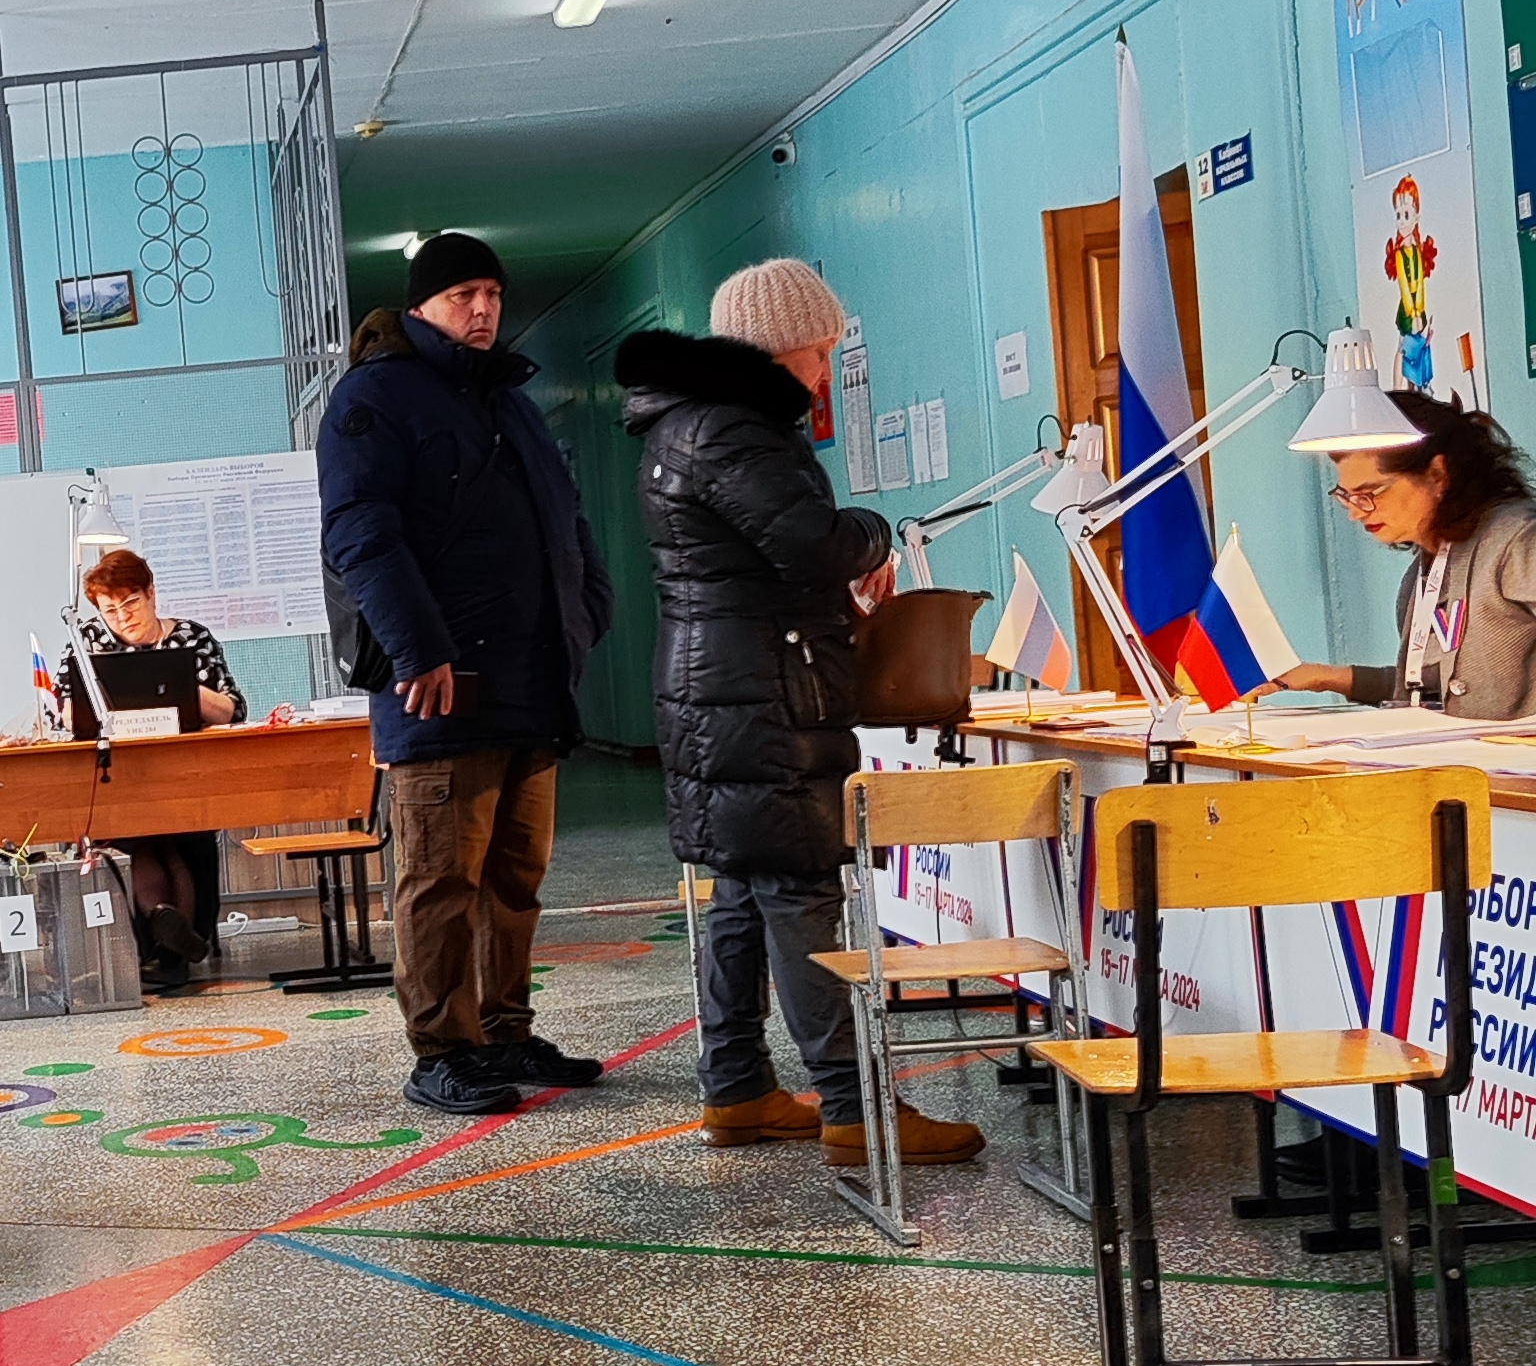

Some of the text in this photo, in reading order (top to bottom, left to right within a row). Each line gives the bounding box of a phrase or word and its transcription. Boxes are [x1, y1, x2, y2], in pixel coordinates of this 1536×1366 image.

[1198, 157, 1209, 177] 12
[229, 462, 264, 471] ВЫБОРОВ
[113, 715, 172, 726] РЕДСЕДАТЕЛЬ
[915, 844, 951, 882] РОССИИ
[93, 900, 107, 919] 1
[9, 910, 27, 937] 2
[1171, 972, 1201, 1013] 2024
[1477, 1079, 1536, 1141] МАРТ
